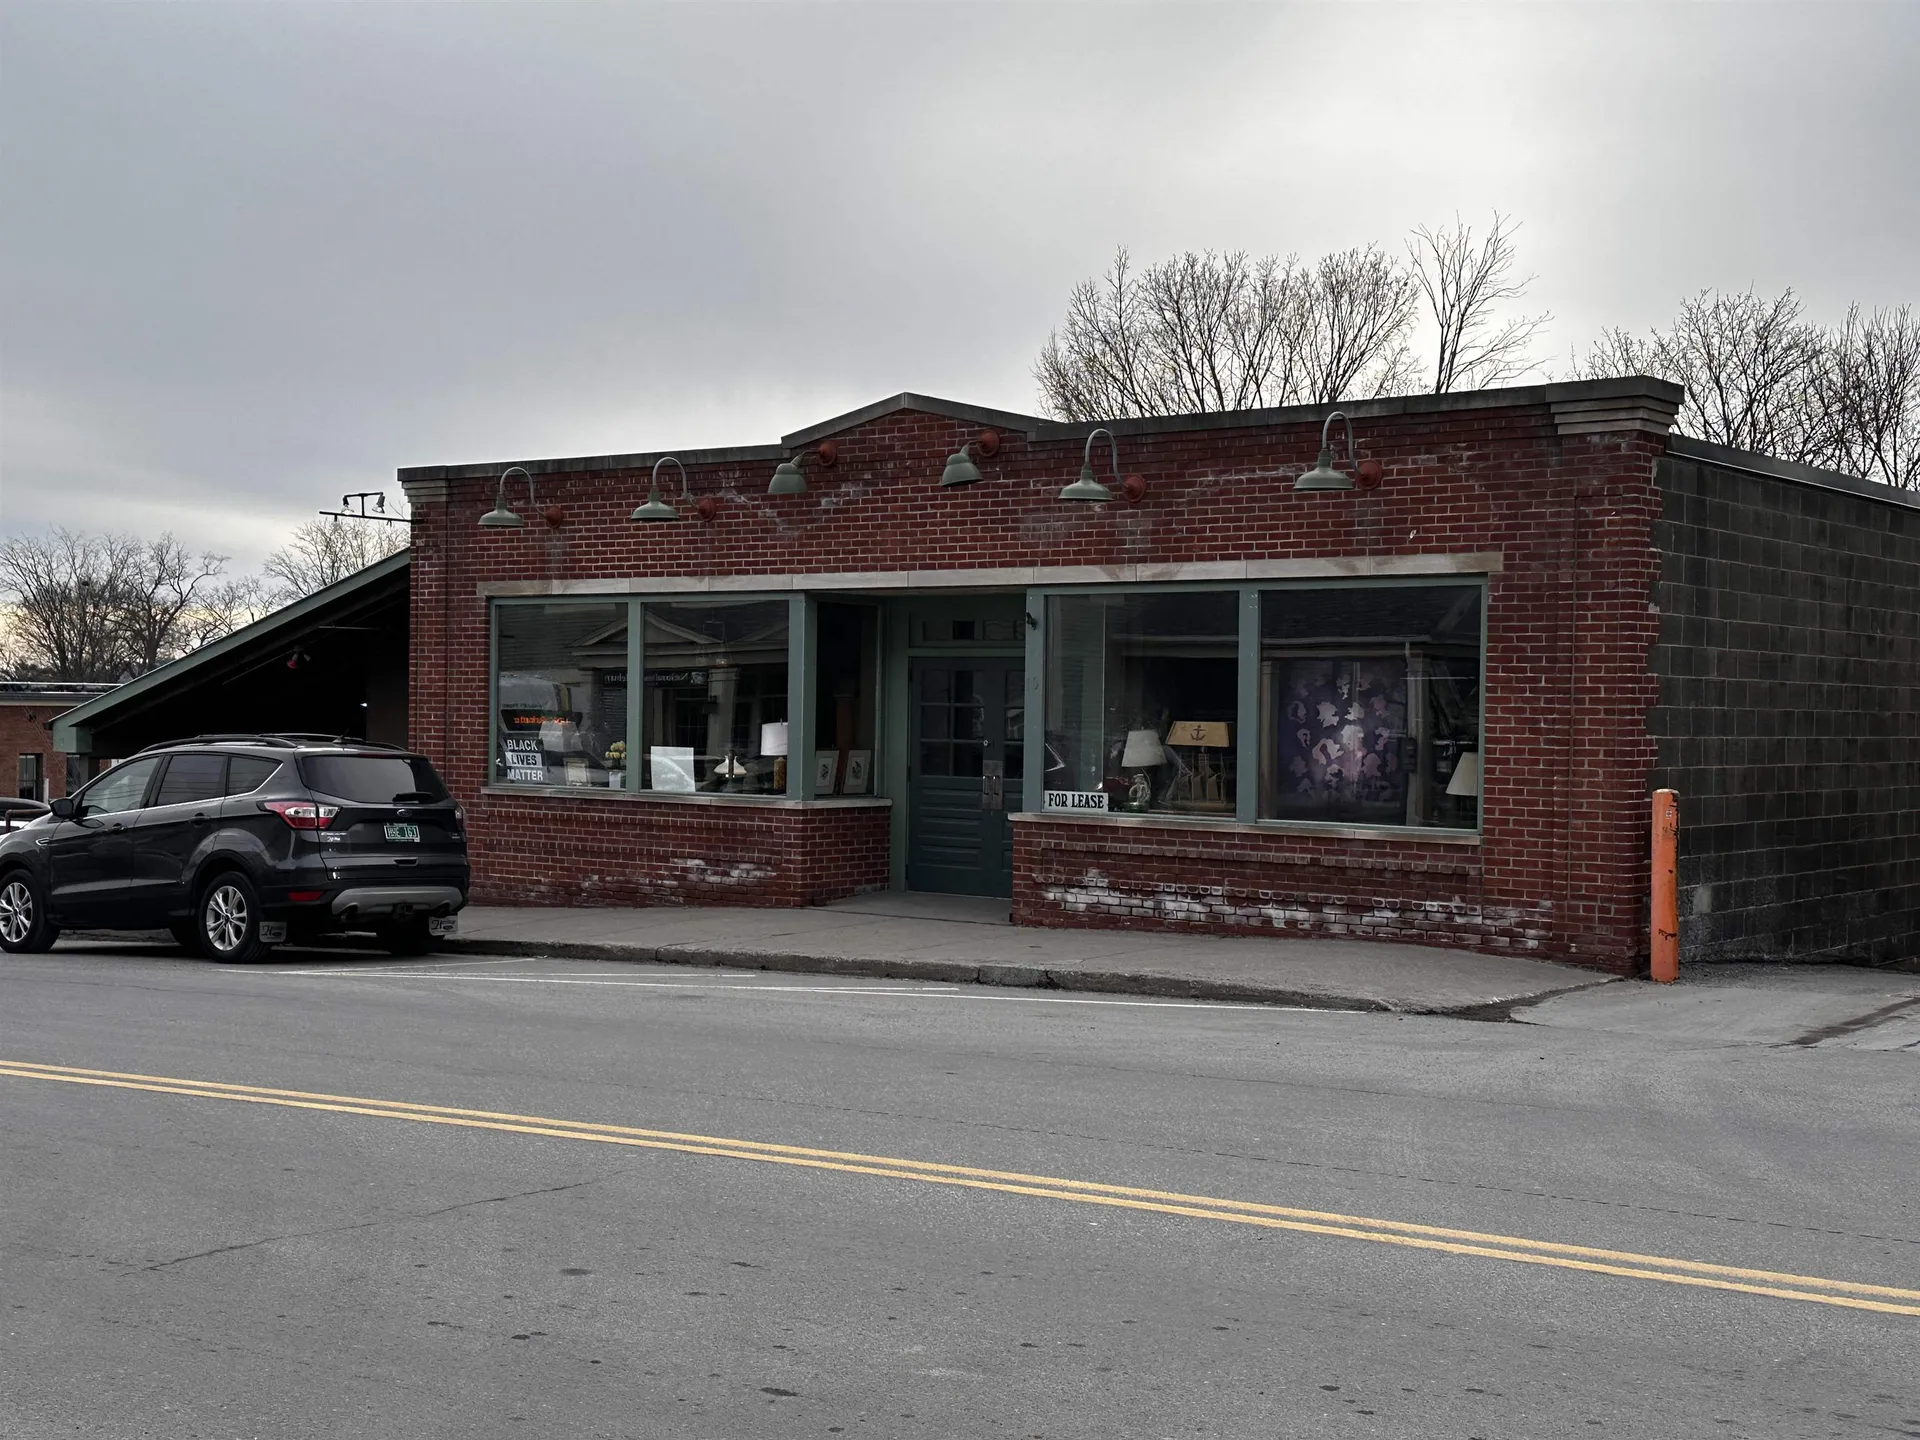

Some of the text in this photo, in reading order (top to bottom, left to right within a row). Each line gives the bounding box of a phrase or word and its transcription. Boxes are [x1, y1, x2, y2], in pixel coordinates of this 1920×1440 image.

[507, 739, 538, 751] BLACK
[511, 754, 537, 766] LIVES
[507, 768, 543, 781] MATTER
[1048, 793, 1104, 809] FOR LEASE
